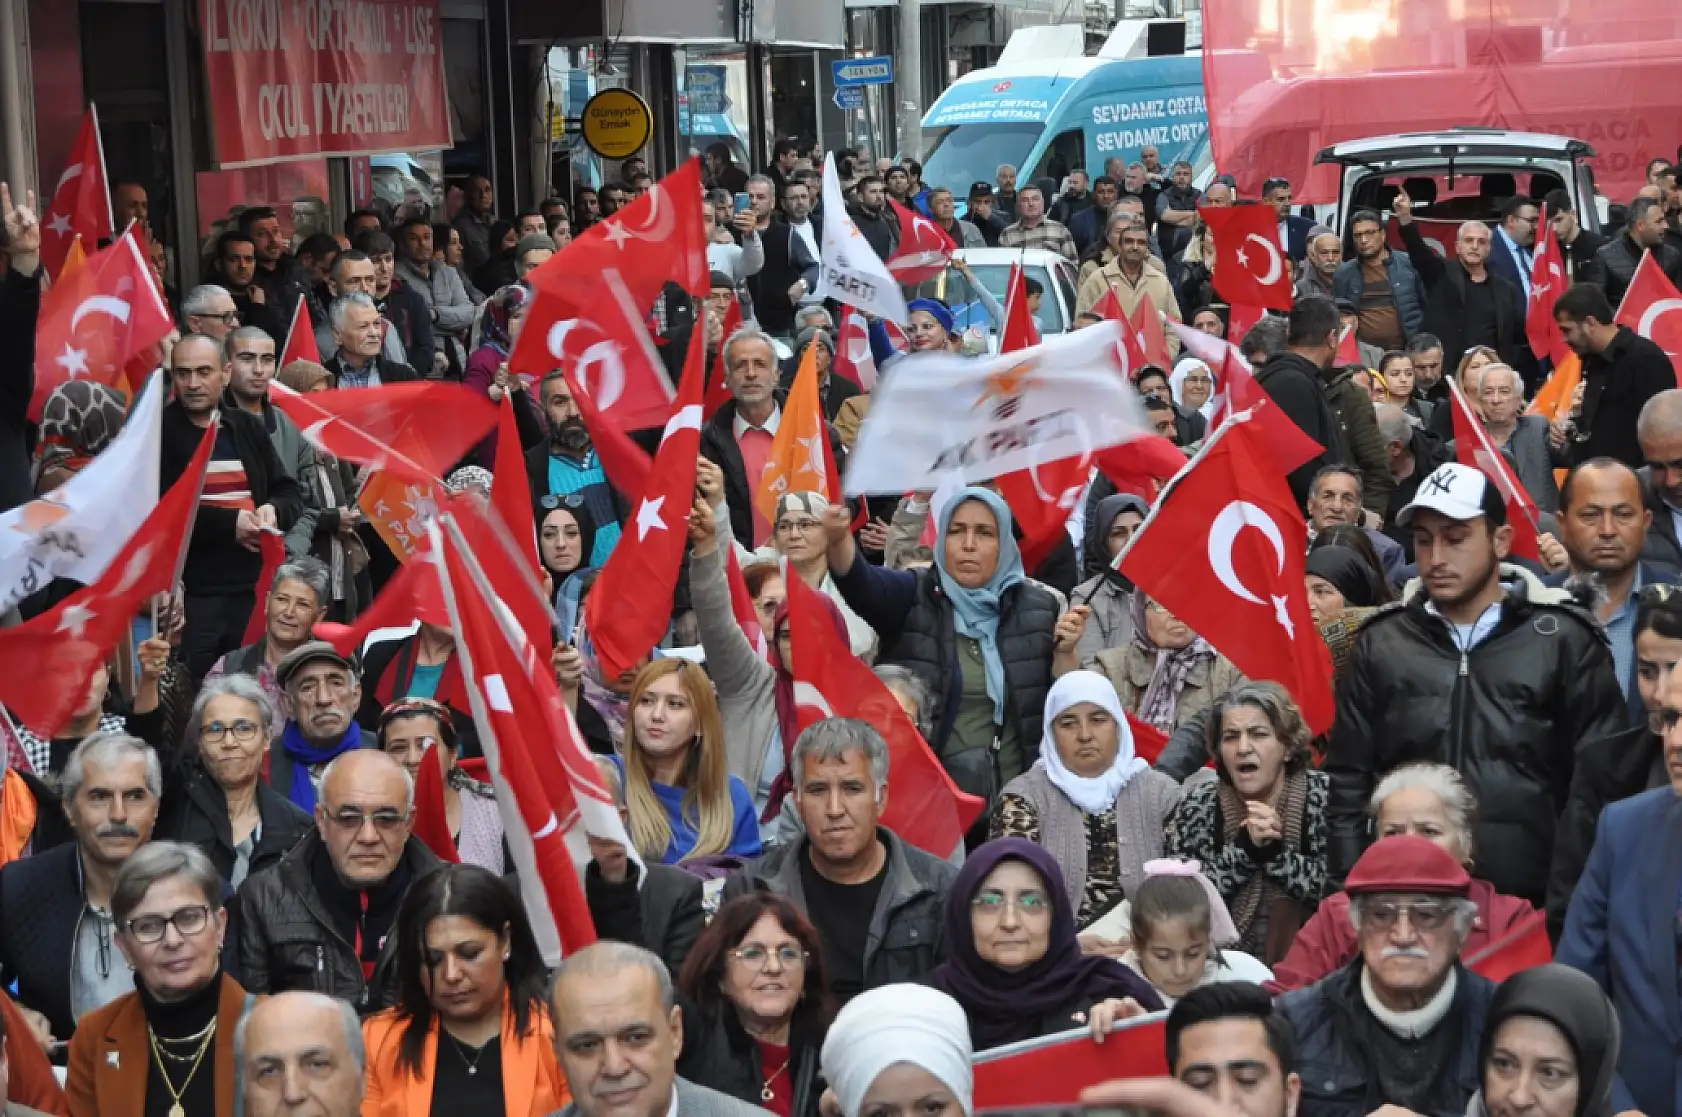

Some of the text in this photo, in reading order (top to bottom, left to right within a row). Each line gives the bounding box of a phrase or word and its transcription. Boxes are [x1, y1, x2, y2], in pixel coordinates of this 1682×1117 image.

[258, 83, 310, 141] OKUL
[599, 119, 631, 130] Emlak
[1092, 99, 1166, 125] SEVDAMIZ
[1096, 126, 1170, 151] SEVDAMIZ
